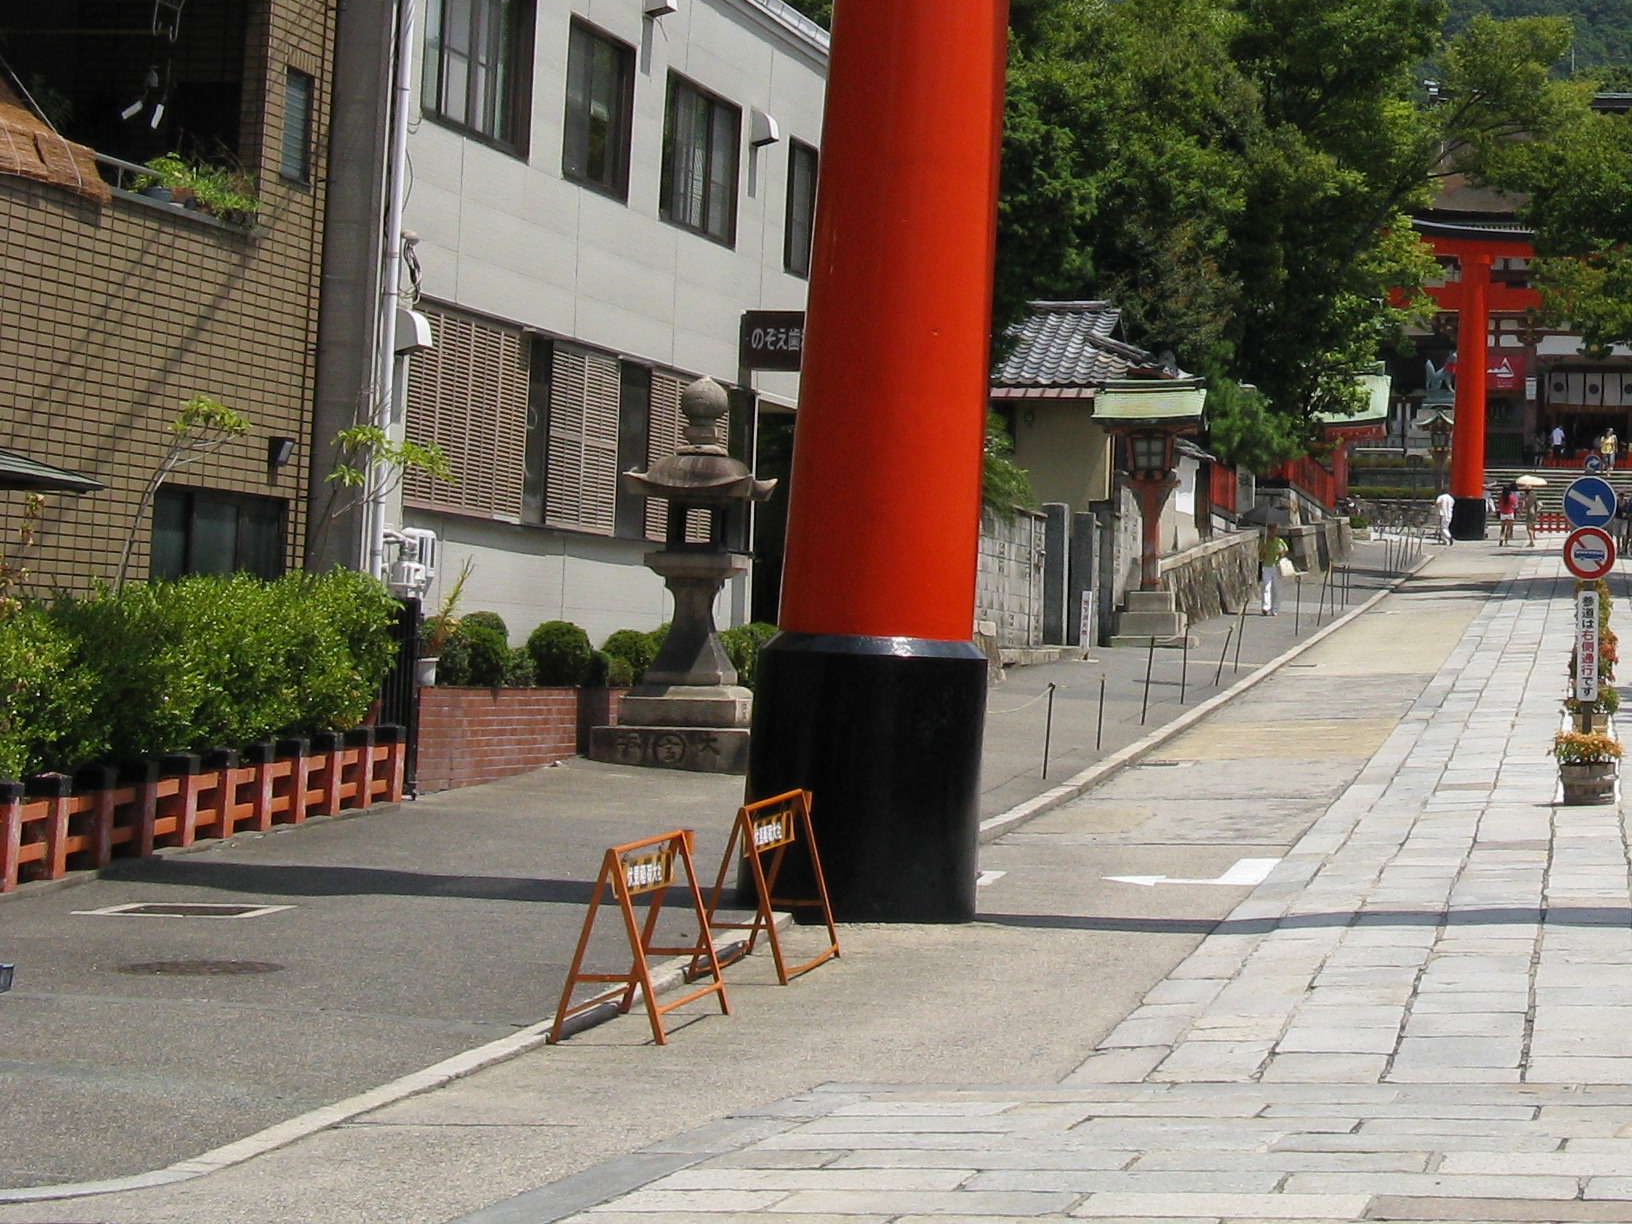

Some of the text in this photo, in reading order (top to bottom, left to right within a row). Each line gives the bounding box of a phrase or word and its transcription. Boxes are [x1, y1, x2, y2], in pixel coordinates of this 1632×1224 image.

[751, 327, 804, 351] のぞえ歯
[1580, 595, 1595, 697] 参道は右側通行です
